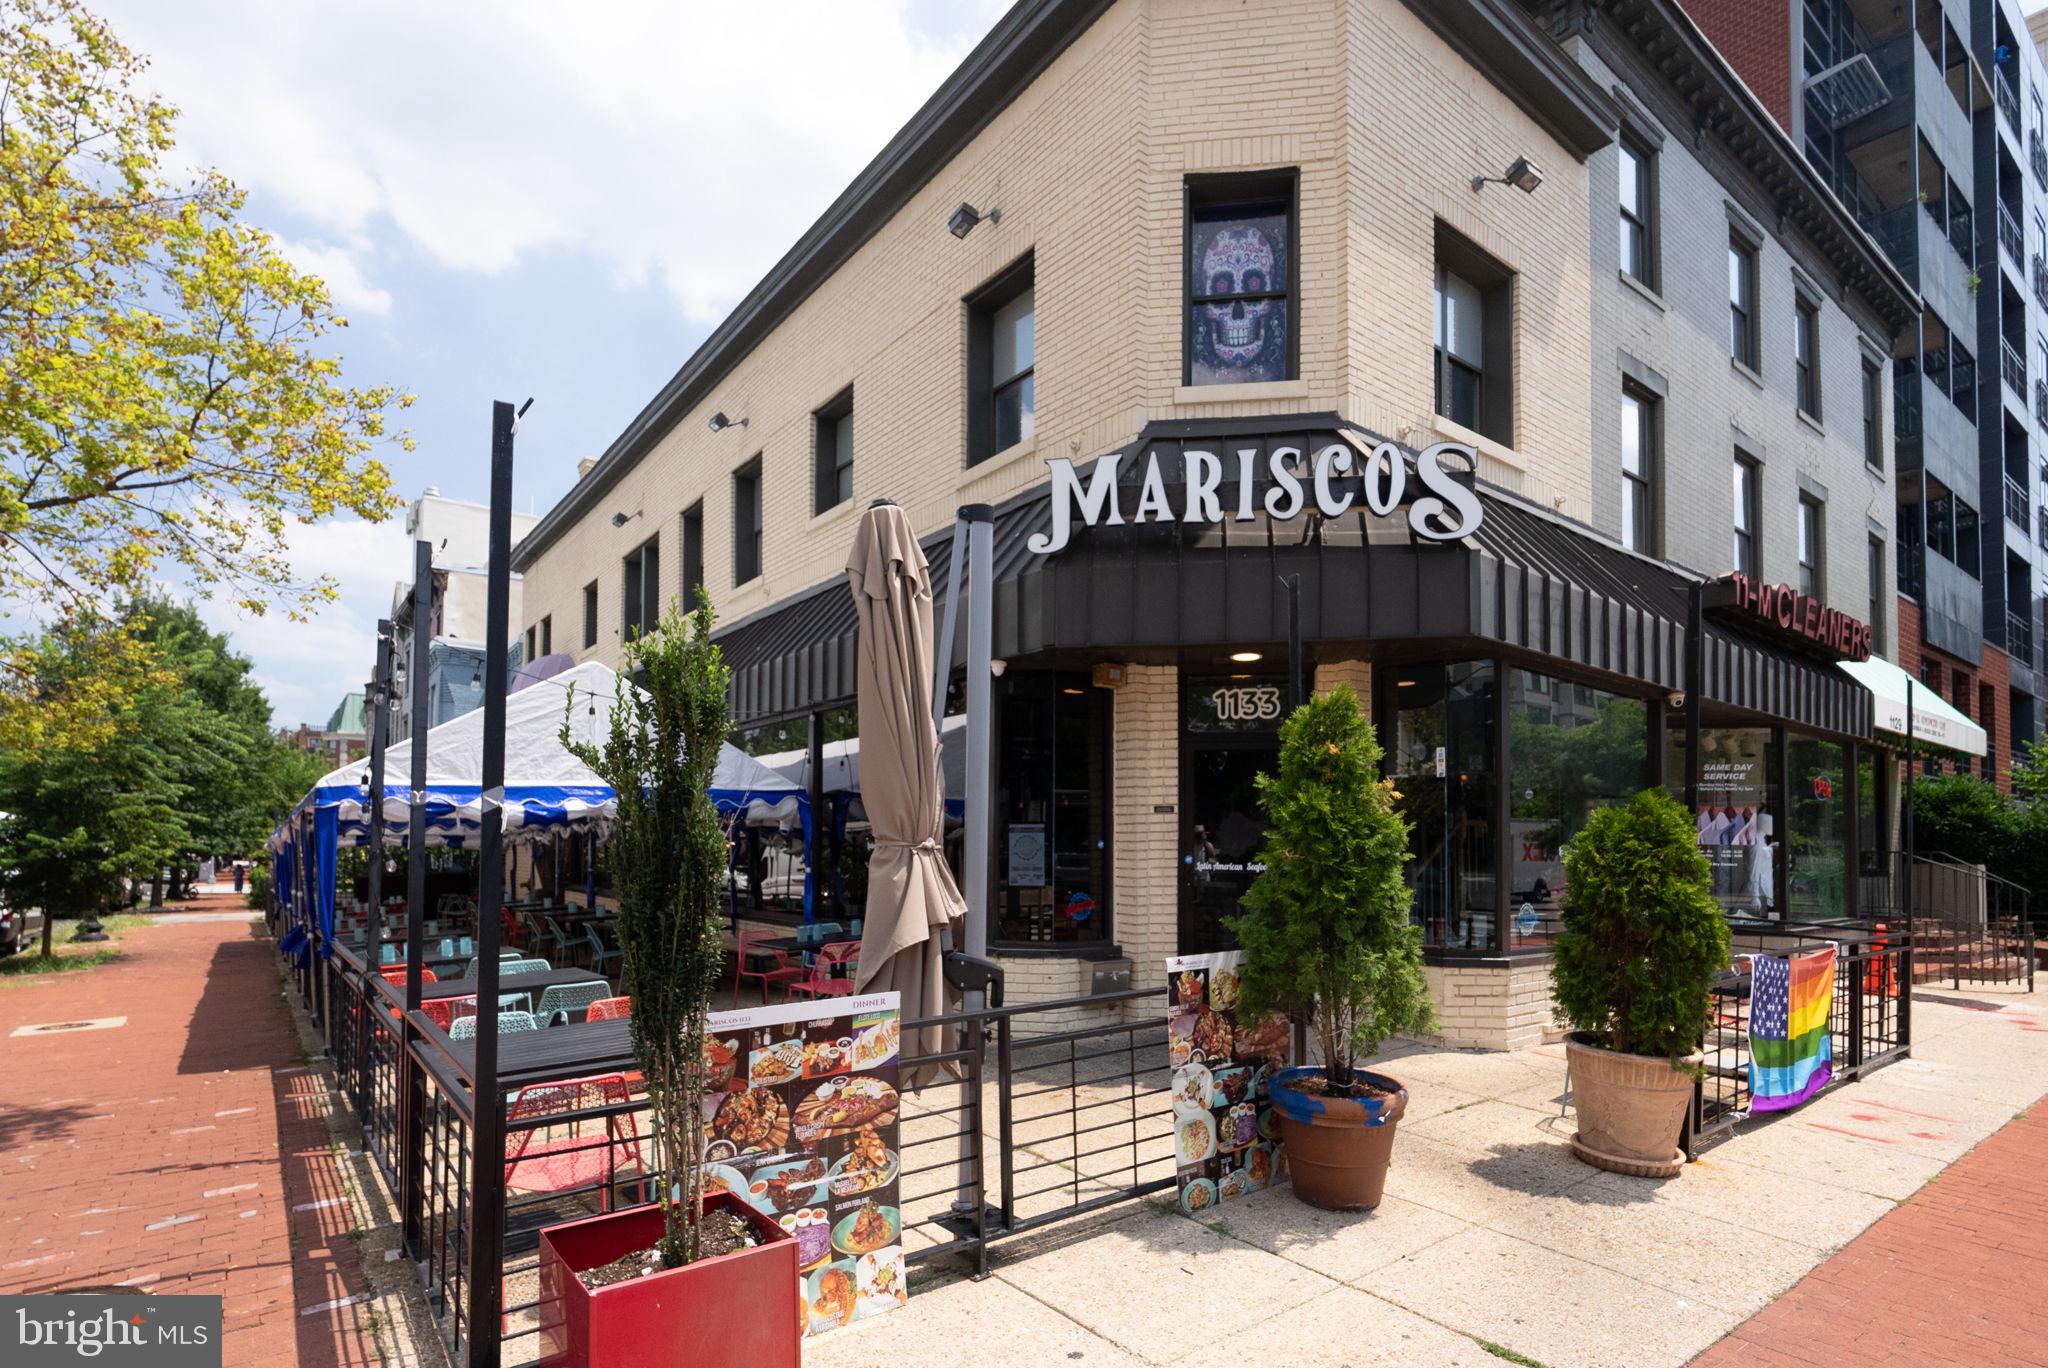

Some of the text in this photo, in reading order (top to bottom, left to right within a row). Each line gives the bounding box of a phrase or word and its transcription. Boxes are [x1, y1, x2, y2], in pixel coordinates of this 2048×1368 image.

[1027, 441, 1484, 554] MARISCOS
[1777, 583, 1873, 663] CLEANERS
[1213, 687, 1281, 720] 1133
[1703, 763, 1754, 771] SAME DAY
[1703, 772, 1746, 780] SERVICE
[1196, 861, 1268, 873] Latin American Seafoo
[853, 998, 887, 1009] DINNER
